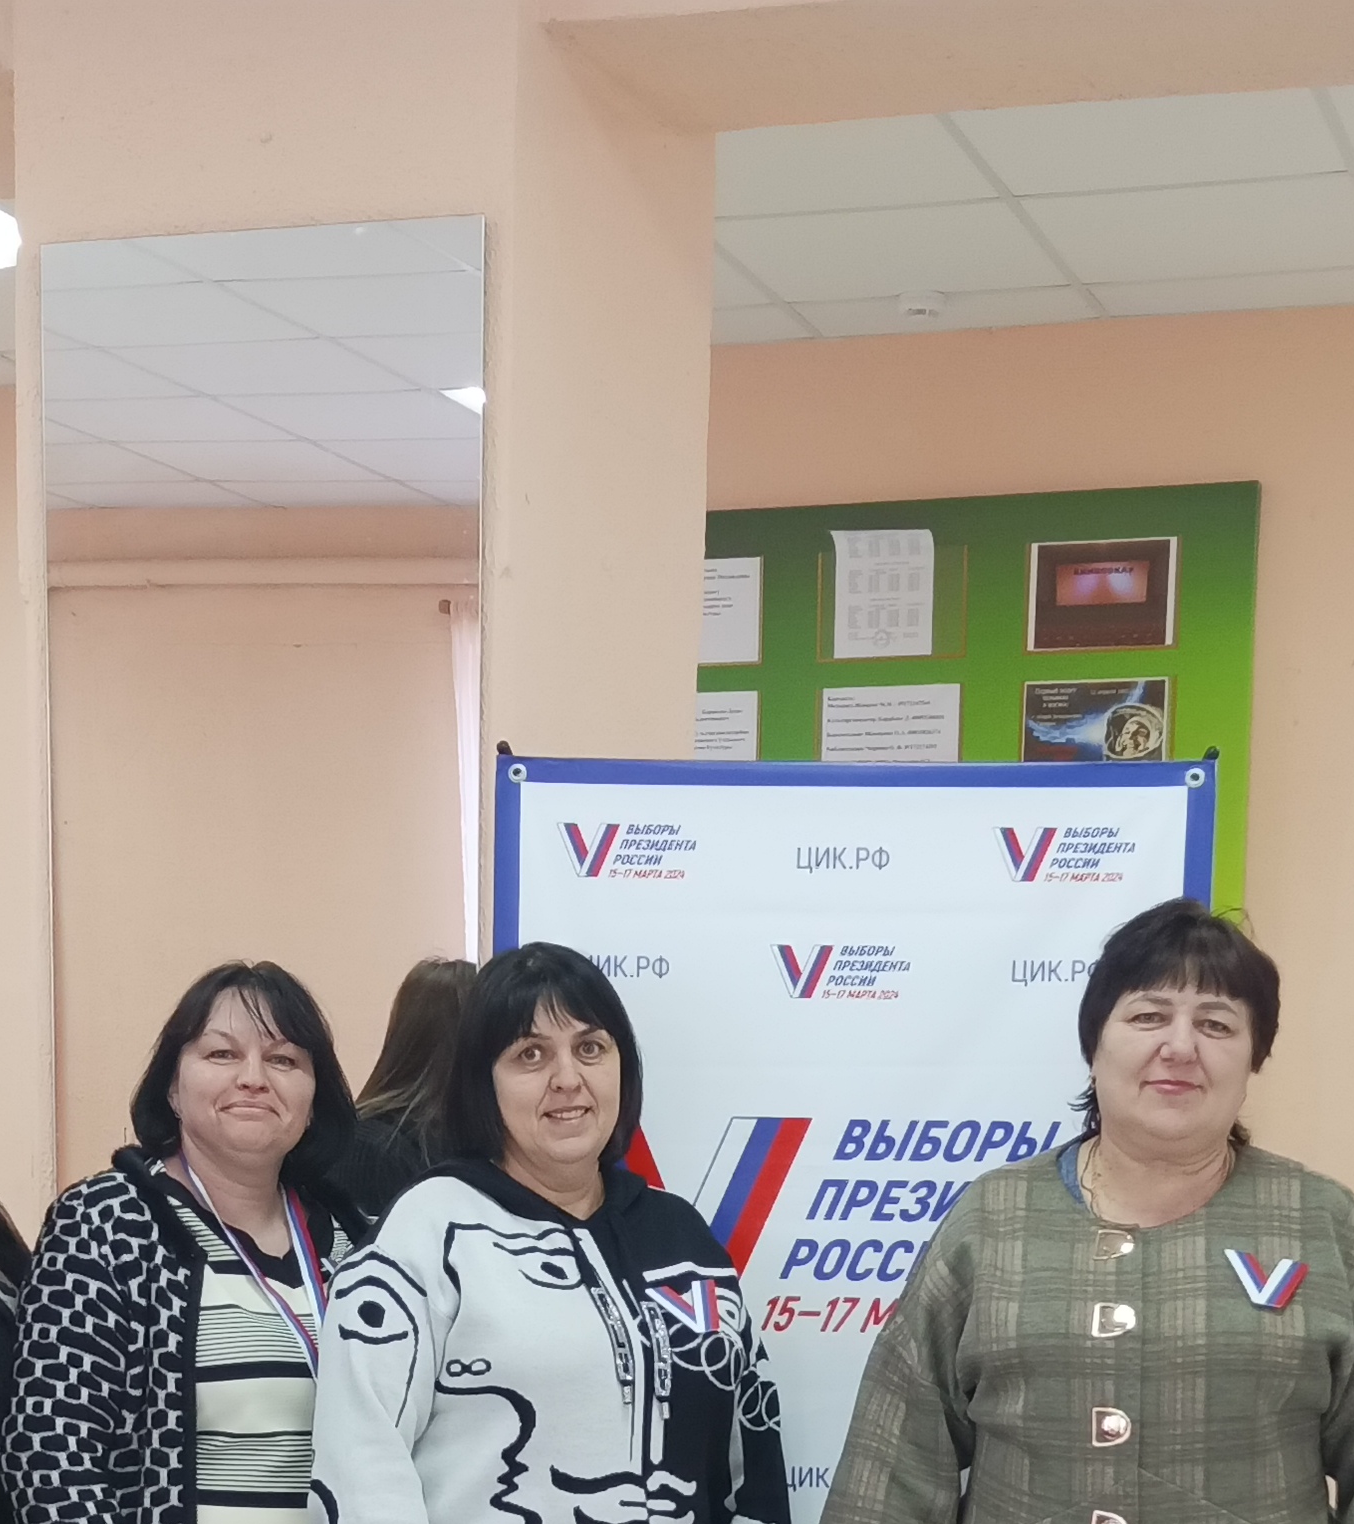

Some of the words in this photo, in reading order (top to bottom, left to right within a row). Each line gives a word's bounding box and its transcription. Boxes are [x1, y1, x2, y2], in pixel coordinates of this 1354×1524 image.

[626, 824, 681, 835] ВЫБОРЫ
[1063, 827, 1120, 839] ВЫБОРЫ
[619, 839, 696, 851] ПРЕЗИДЕНТА
[1056, 842, 1136, 854] ПРЕЗИДЕНТА
[613, 855, 663, 866] РОССИИ
[796, 846, 890, 874] ЦИК.РФ
[1049, 858, 1101, 869] РОССИИ
[633, 870, 663, 879] МАРТА
[1070, 873, 1099, 882] МАРТА
[840, 945, 895, 956] ВЫБОРЫ
[589, 955, 670, 979] ИК.РФ
[833, 960, 911, 972] ПРЕЗИДЕНТА
[826, 975, 877, 986] РОССИИ
[846, 990, 876, 999] МАРТА
[832, 1119, 1062, 1163] ВЫБОРЫ
[805, 1179, 974, 1222] ПРЕЗИ
